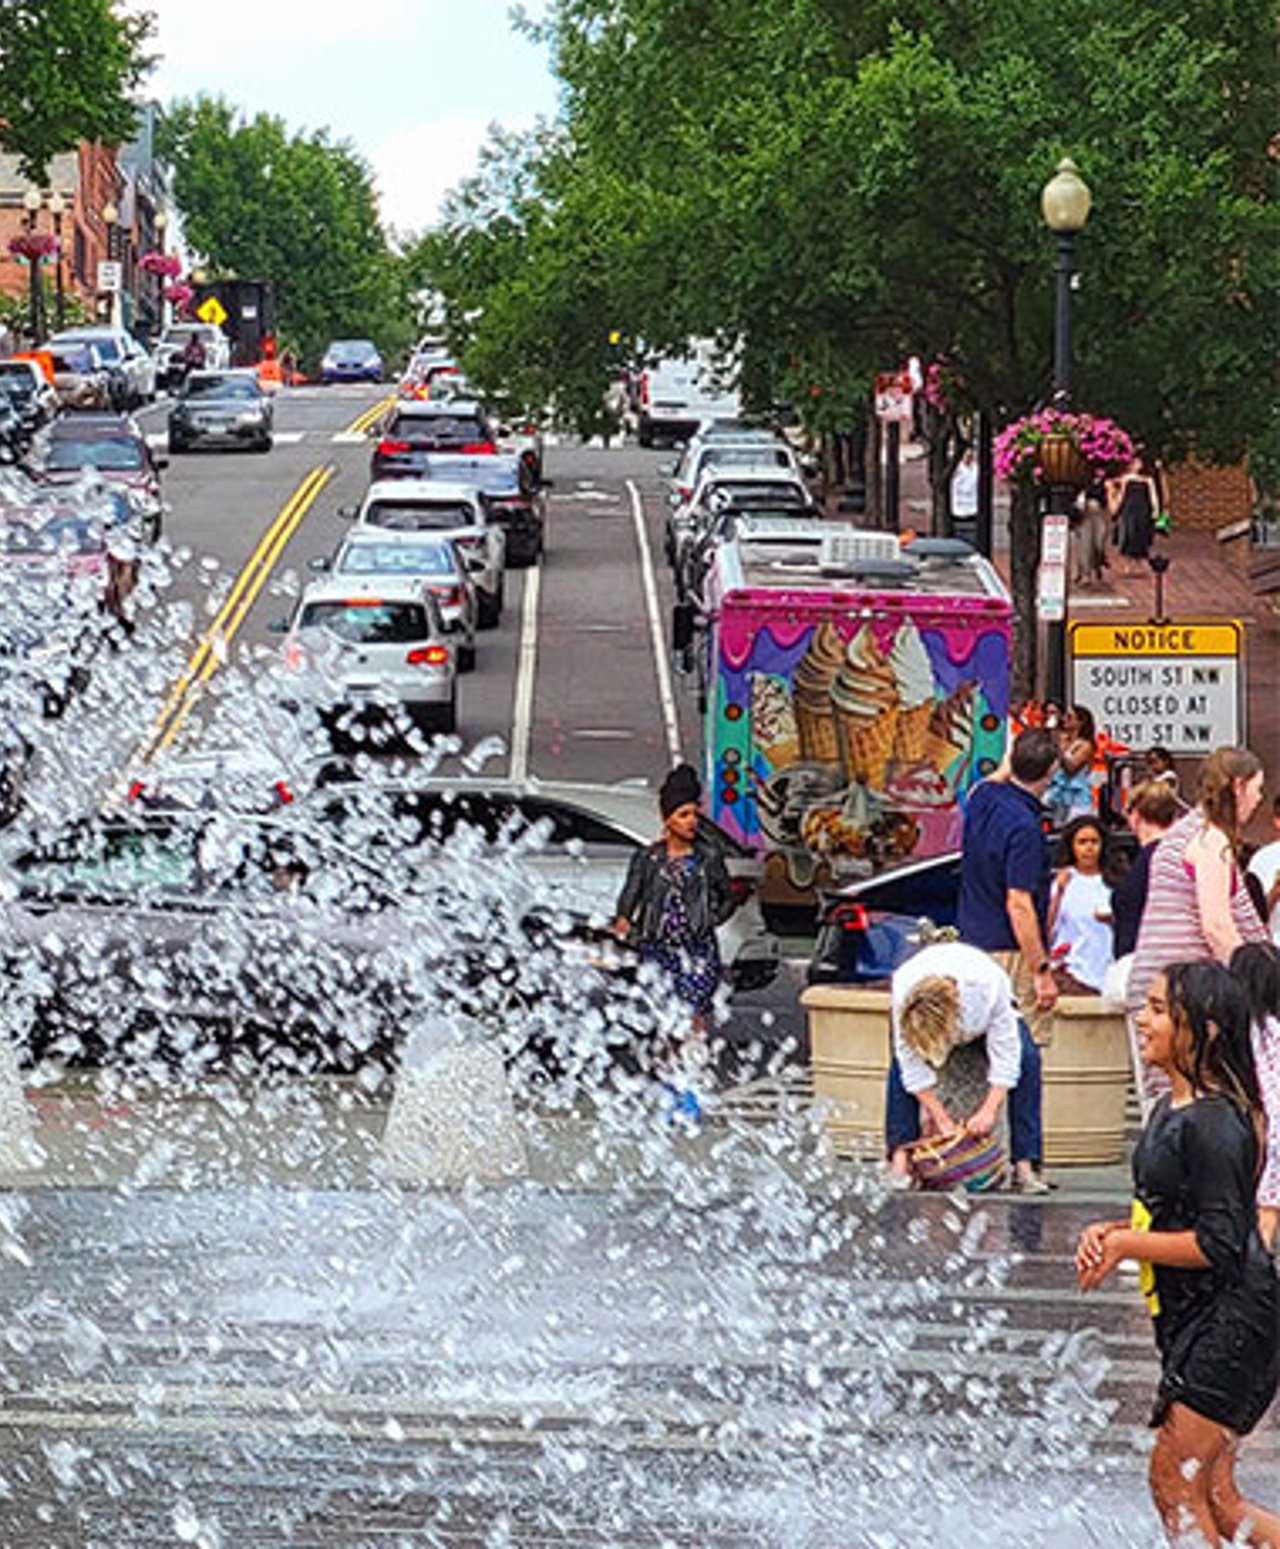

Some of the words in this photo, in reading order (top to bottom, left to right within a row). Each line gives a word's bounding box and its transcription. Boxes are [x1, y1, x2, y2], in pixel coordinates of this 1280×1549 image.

[1114, 631, 1196, 650] NOTICE
[1090, 667, 1153, 687] SOUTH
[1161, 667, 1183, 685] ST
[1192, 668, 1220, 684] NW
[1104, 696, 1179, 715] CLOSED
[1186, 696, 1207, 714] AT
[1151, 724, 1174, 742] ST
[1182, 724, 1213, 742] NW
